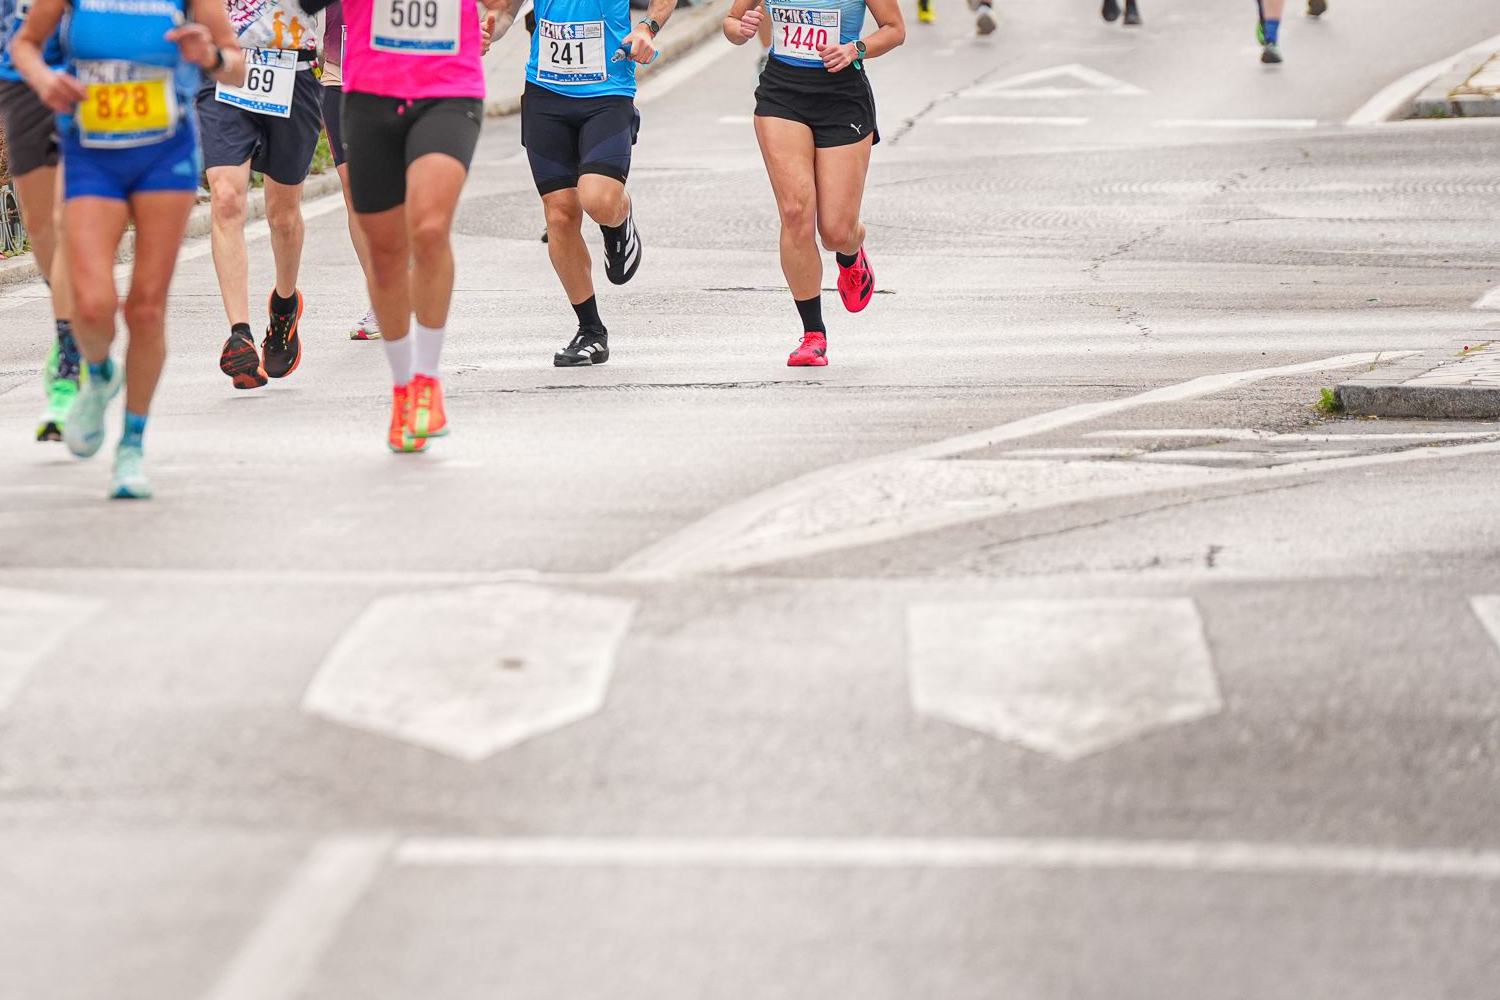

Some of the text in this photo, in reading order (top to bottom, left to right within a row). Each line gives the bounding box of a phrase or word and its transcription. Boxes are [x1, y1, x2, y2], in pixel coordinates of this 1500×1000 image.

[390, 0, 437, 28] 509
[782, 25, 828, 52] 1440
[550, 41, 584, 65] 241
[96, 84, 150, 120] 828
